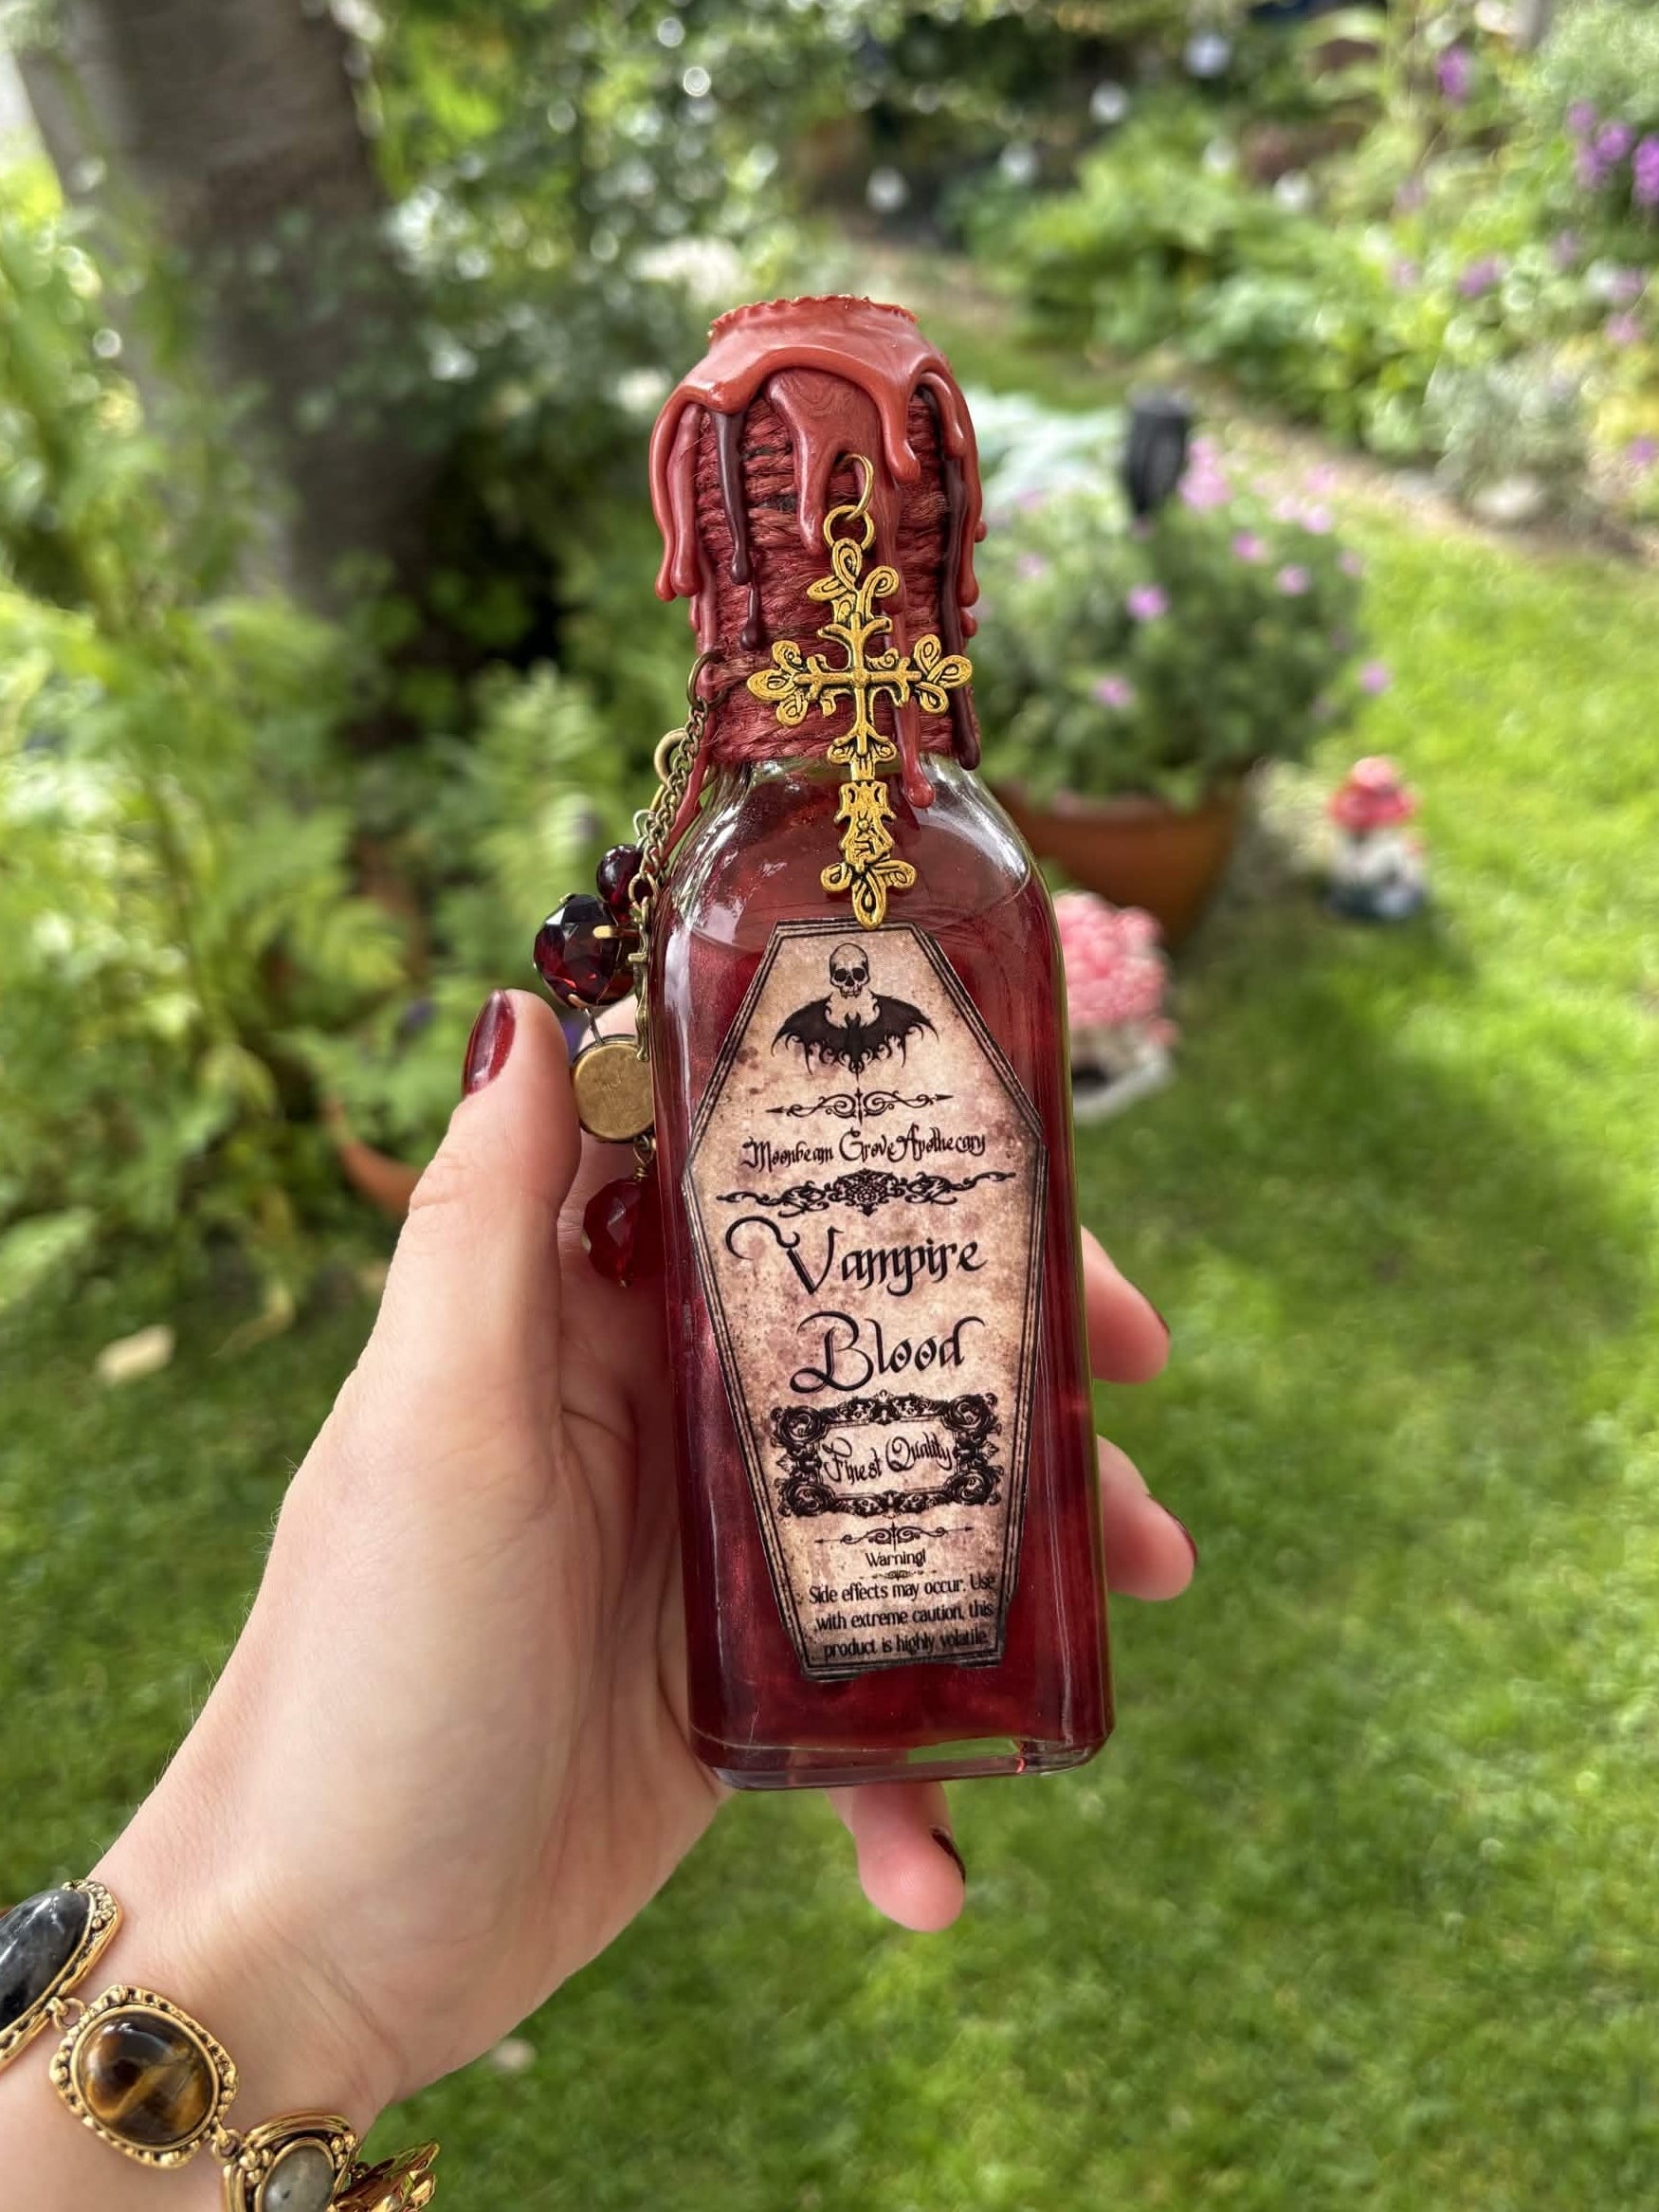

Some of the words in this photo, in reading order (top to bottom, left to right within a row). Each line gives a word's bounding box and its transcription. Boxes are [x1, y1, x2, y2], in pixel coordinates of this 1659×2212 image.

[739, 1136, 834, 1173] Moonbeam
[838, 1127, 894, 1162] Grove
[886, 1123, 985, 1161] Apothecary
[725, 1216, 988, 1296] Vampire
[789, 1310, 985, 1394] Blood
[822, 1436, 882, 1485] Finest
[884, 1431, 952, 1472] Quality
[865, 1548, 926, 1567] Warning!
[809, 1585, 838, 1604] Side
[841, 1582, 889, 1601] effects
[891, 1581, 921, 1602] may
[923, 1578, 967, 1595] occur.
[815, 1613, 848, 1632] with
[849, 1609, 908, 1628] extreme
[968, 1599, 994, 1618] this
[823, 1636, 877, 1660] product
[881, 1636, 892, 1654] is
[896, 1630, 936, 1654] highly
